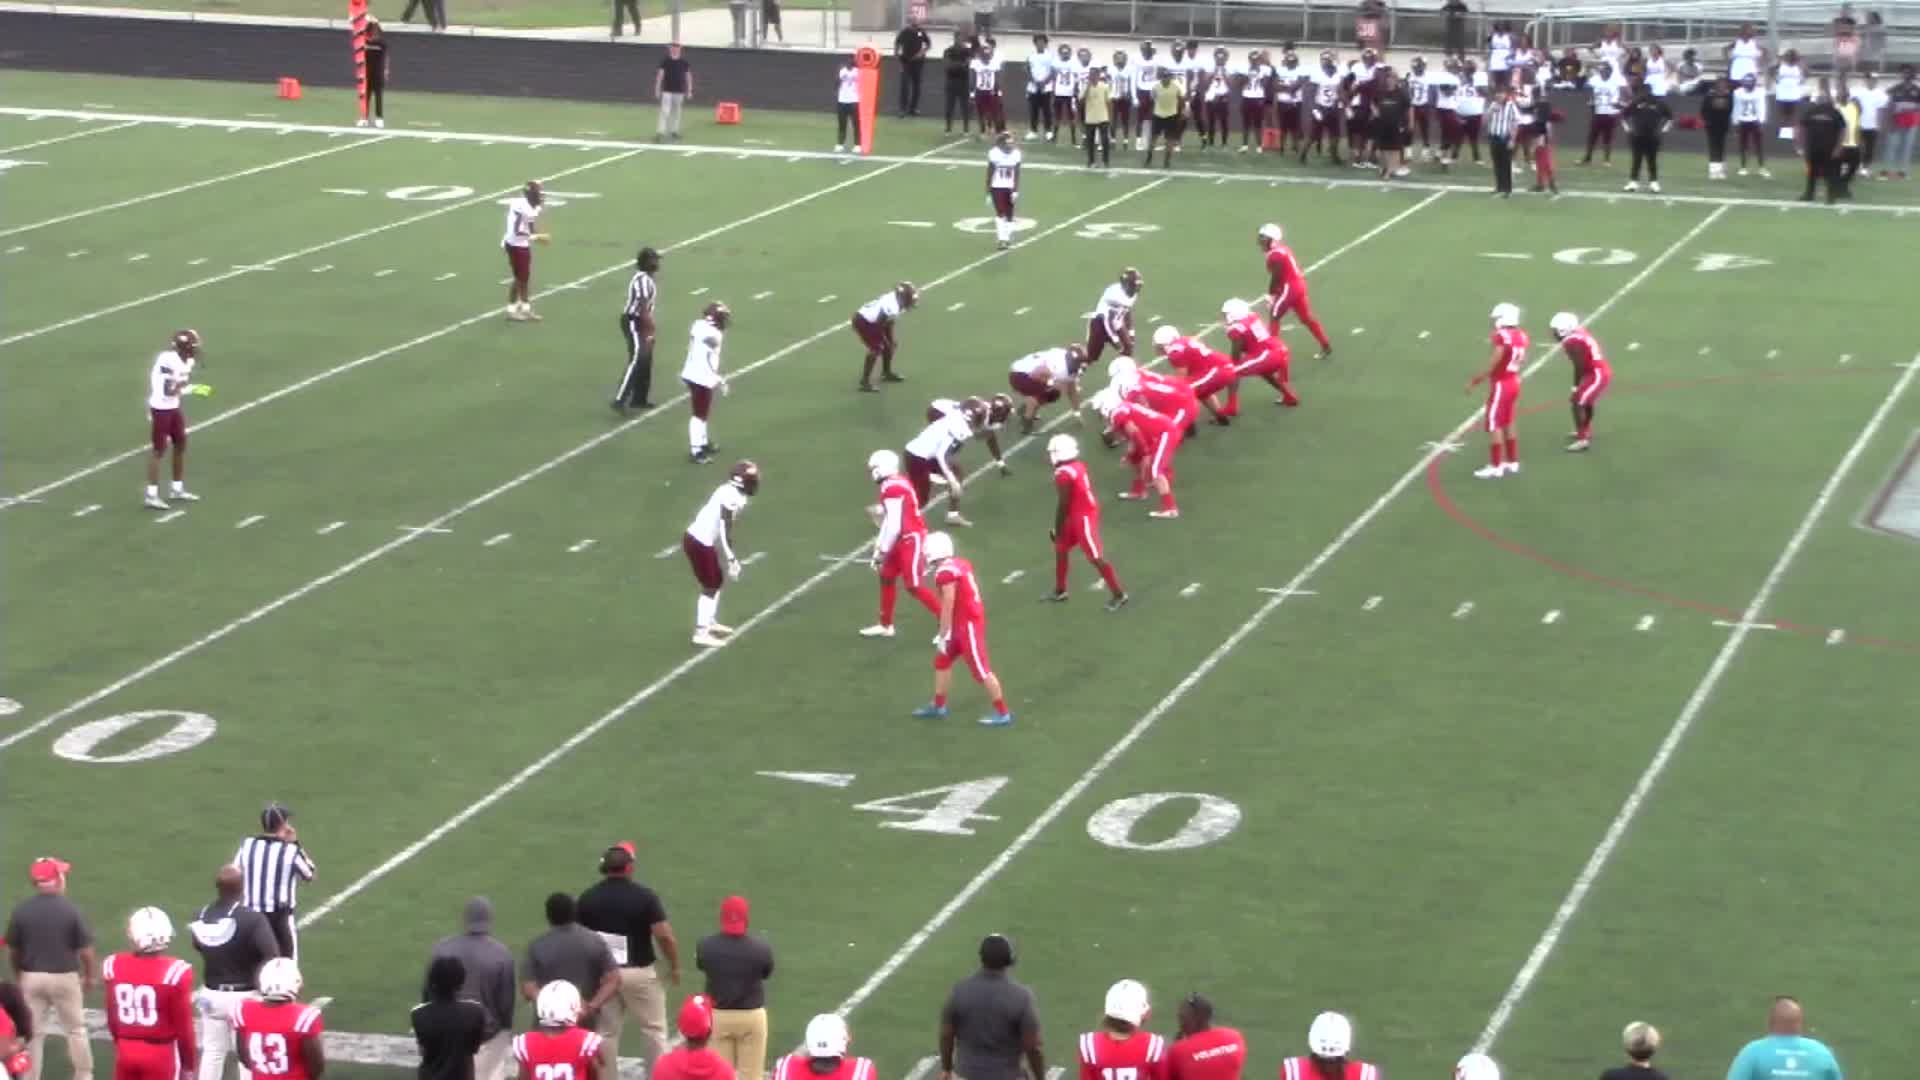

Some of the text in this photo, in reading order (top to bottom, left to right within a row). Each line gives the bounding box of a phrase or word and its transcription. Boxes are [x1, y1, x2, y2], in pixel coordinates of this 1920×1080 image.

[853, 776, 1242, 850] 40
[115, 983, 158, 1026] 80
[249, 1031, 289, 1075] 43
